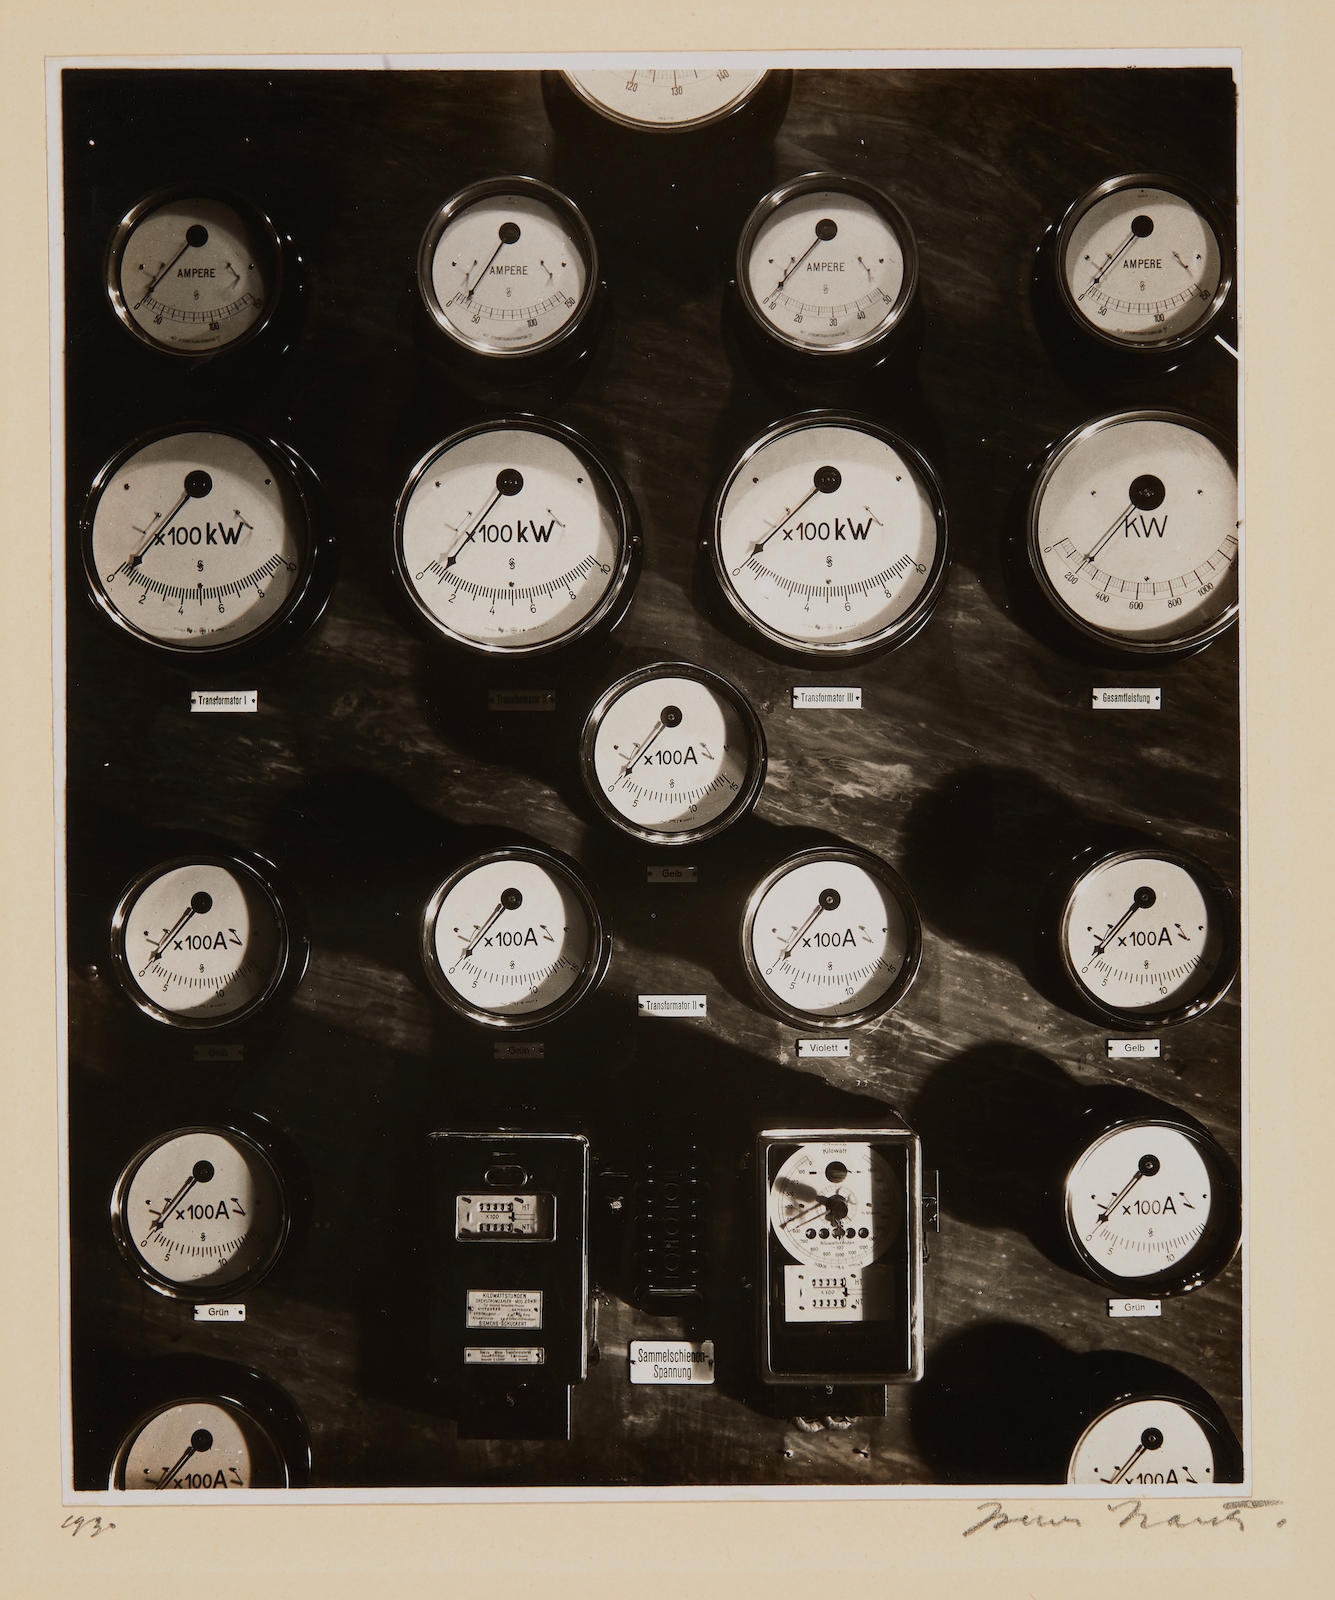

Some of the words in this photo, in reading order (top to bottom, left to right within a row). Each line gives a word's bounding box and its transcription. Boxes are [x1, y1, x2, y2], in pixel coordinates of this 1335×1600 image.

[716, 69, 730, 82] 140
[625, 80, 638, 92] 120
[671, 86, 683, 96] 130
[806, 262, 845, 272] AMPERE
[1123, 258, 1162, 269] AMPERE
[177, 268, 216, 279] AMPERE
[489, 266, 529, 276] AMPERE
[564, 298, 576, 308] 150
[882, 295, 892, 305] 50
[768, 301, 777, 310] 10
[856, 311, 866, 320] 40
[1097, 307, 1107, 316] 50
[471, 315, 481, 324] 50
[793, 313, 803, 324] 20
[829, 318, 838, 327] 30
[1154, 313, 1165, 322] 100
[526, 318, 538, 328] 100
[600, 564, 611, 575] 10
[732, 568, 741, 577] 0
[915, 564, 926, 575] 10
[106, 574, 115, 583] 0
[415, 571, 424, 581] 0
[1063, 571, 1079, 585] 200
[257, 588, 265, 598] 8
[885, 589, 892, 599] 8
[1196, 582, 1215, 597] 1000
[137, 594, 147, 605] 2
[448, 594, 457, 604] 2
[569, 590, 577, 601] 8
[1095, 591, 1110, 604] 400
[803, 602, 810, 613] 4
[845, 602, 852, 612] 6
[1128, 601, 1144, 610] 600
[1167, 597, 1182, 609] 800
[177, 605, 184, 616] 4
[218, 603, 225, 614] 6
[489, 606, 495, 616] 4
[530, 604, 537, 614] 6
[198, 696, 242, 705] Transformator
[801, 692, 845, 702] Transformator
[1102, 692, 1151, 704] Gesamtleistung
[607, 785, 615, 793] 0
[729, 782, 739, 792] 15
[632, 800, 638, 808] 5
[688, 804, 698, 813] 10
[138, 970, 146, 978] 0
[765, 968, 773, 976] 0
[1081, 966, 1089, 974] 0
[162, 984, 168, 992] 5
[472, 981, 478, 989] 5
[790, 982, 795, 990] 5
[1101, 979, 1108, 987] 5
[215, 989, 225, 998] 10
[528, 985, 538, 994] 10
[844, 987, 854, 996] 10
[1158, 986, 1168, 995] 10
[646, 1000, 690, 1010] Transformator
[692, 1000, 697, 1010] II
[810, 1044, 838, 1052] Violett
[1124, 1043, 1145, 1052] Gelb
[1085, 1234, 1093, 1242] 0
[140, 1240, 148, 1248] 0
[164, 1253, 170, 1262] 5
[218, 1258, 228, 1267] 10
[1166, 1254, 1175, 1263] 10
[208, 1307, 229, 1316] Grün
[638, 1348, 709, 1363] Sammelschienen-
[653, 1364, 692, 1380] Spannung
